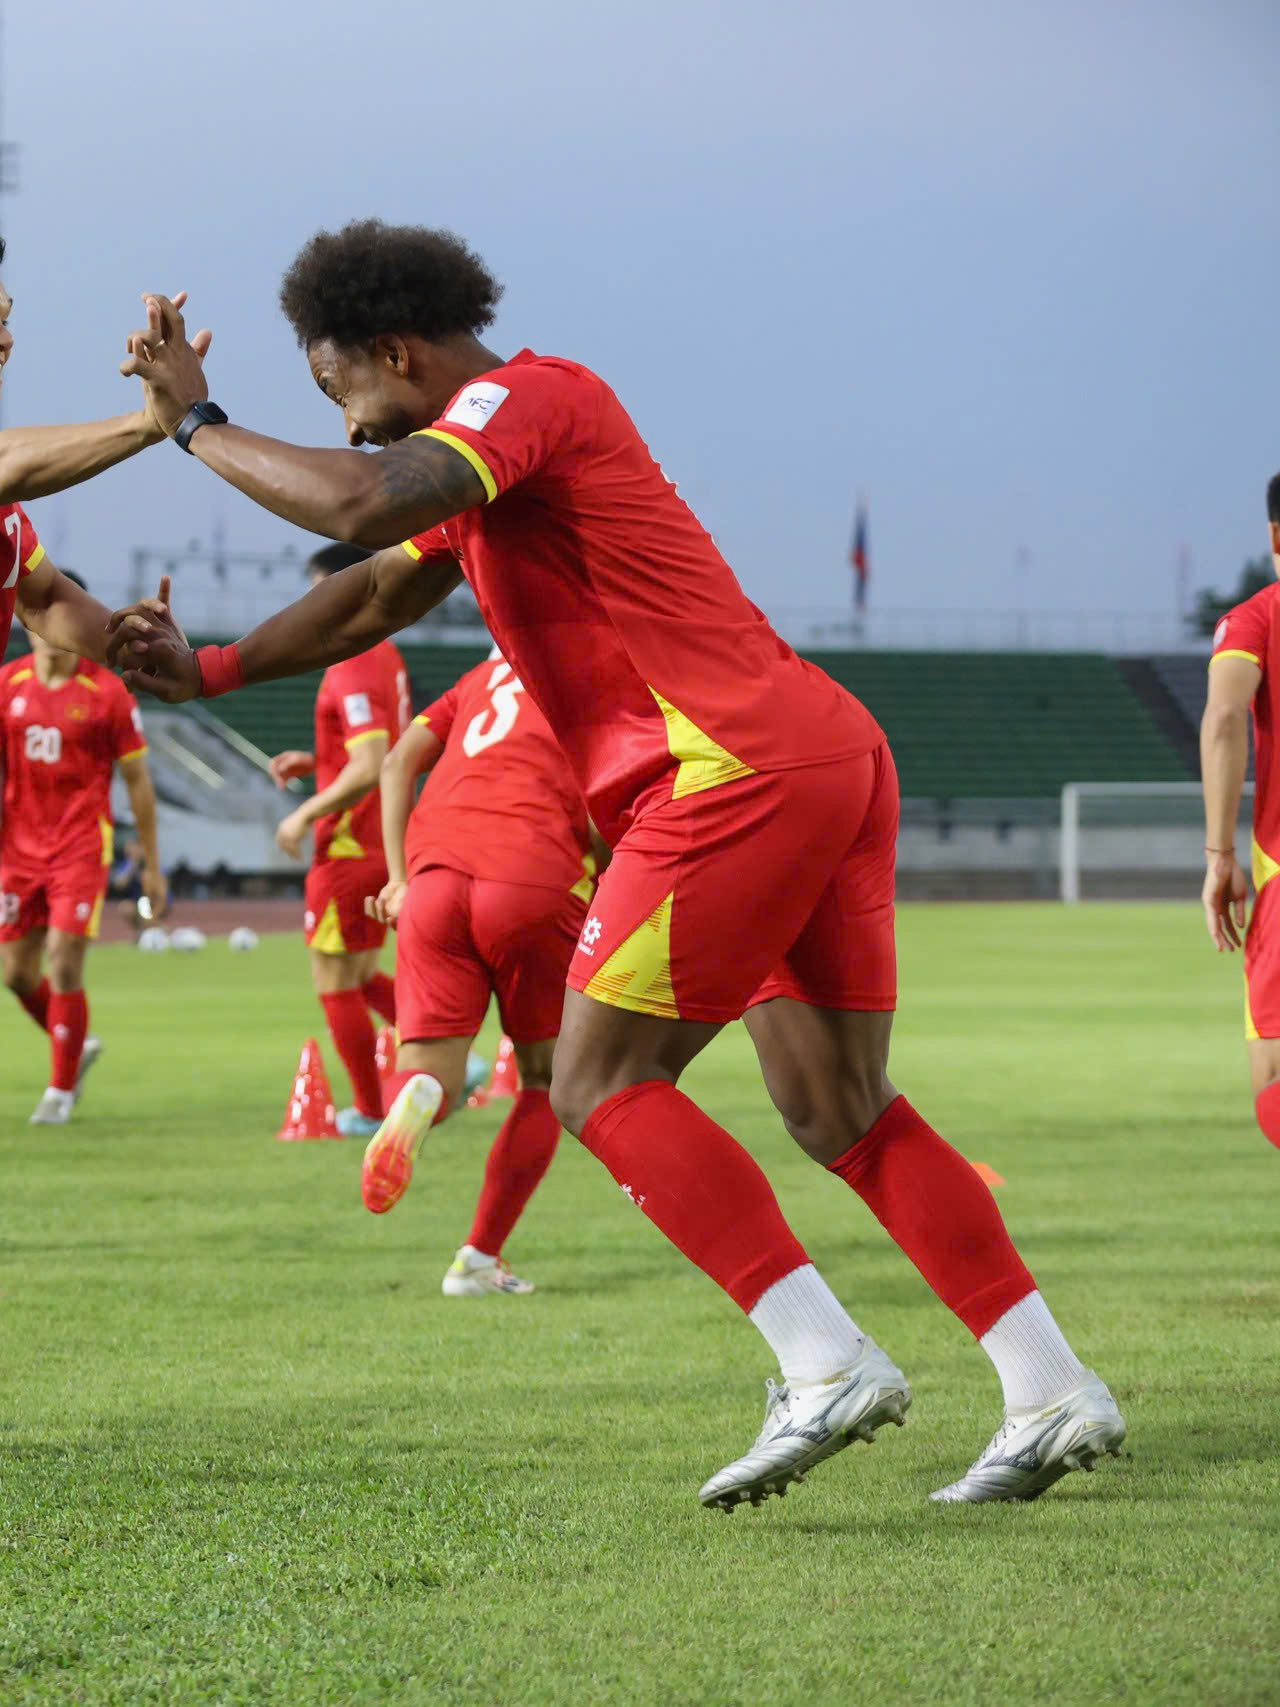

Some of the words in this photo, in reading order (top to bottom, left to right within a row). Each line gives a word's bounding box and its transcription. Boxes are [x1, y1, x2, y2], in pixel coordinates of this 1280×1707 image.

[1, 511, 21, 589] 7
[26, 724, 62, 764] 20
[463, 662, 526, 758] 3
